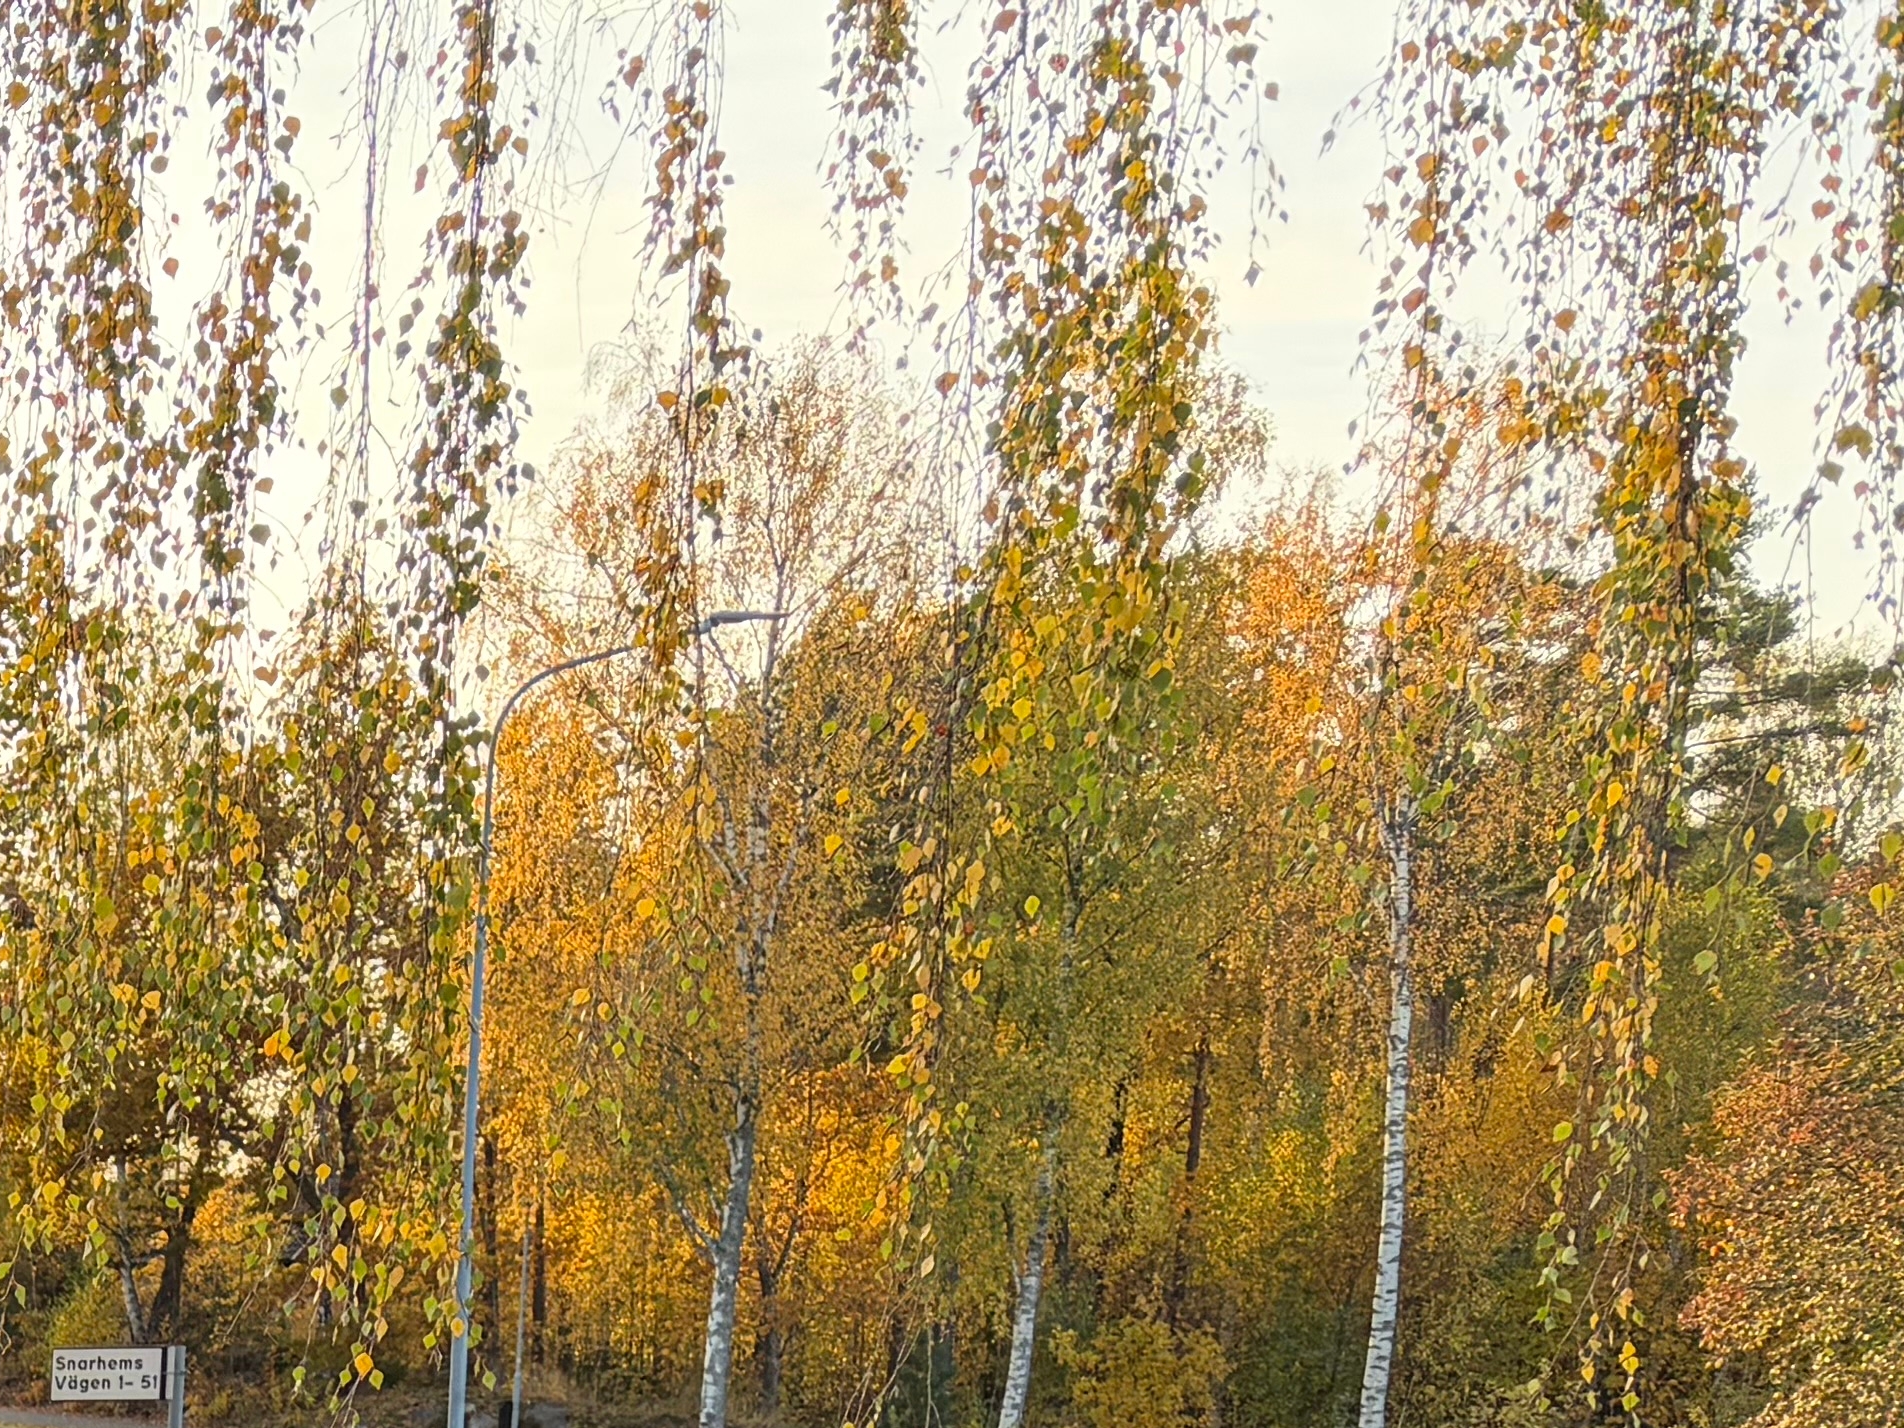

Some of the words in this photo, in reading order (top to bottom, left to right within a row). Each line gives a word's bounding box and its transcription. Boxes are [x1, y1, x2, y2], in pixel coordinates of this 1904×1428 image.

[56, 1356, 143, 1370] Snarhems
[55, 1375, 111, 1393] Vägen
[141, 1375, 157, 1389] 51
